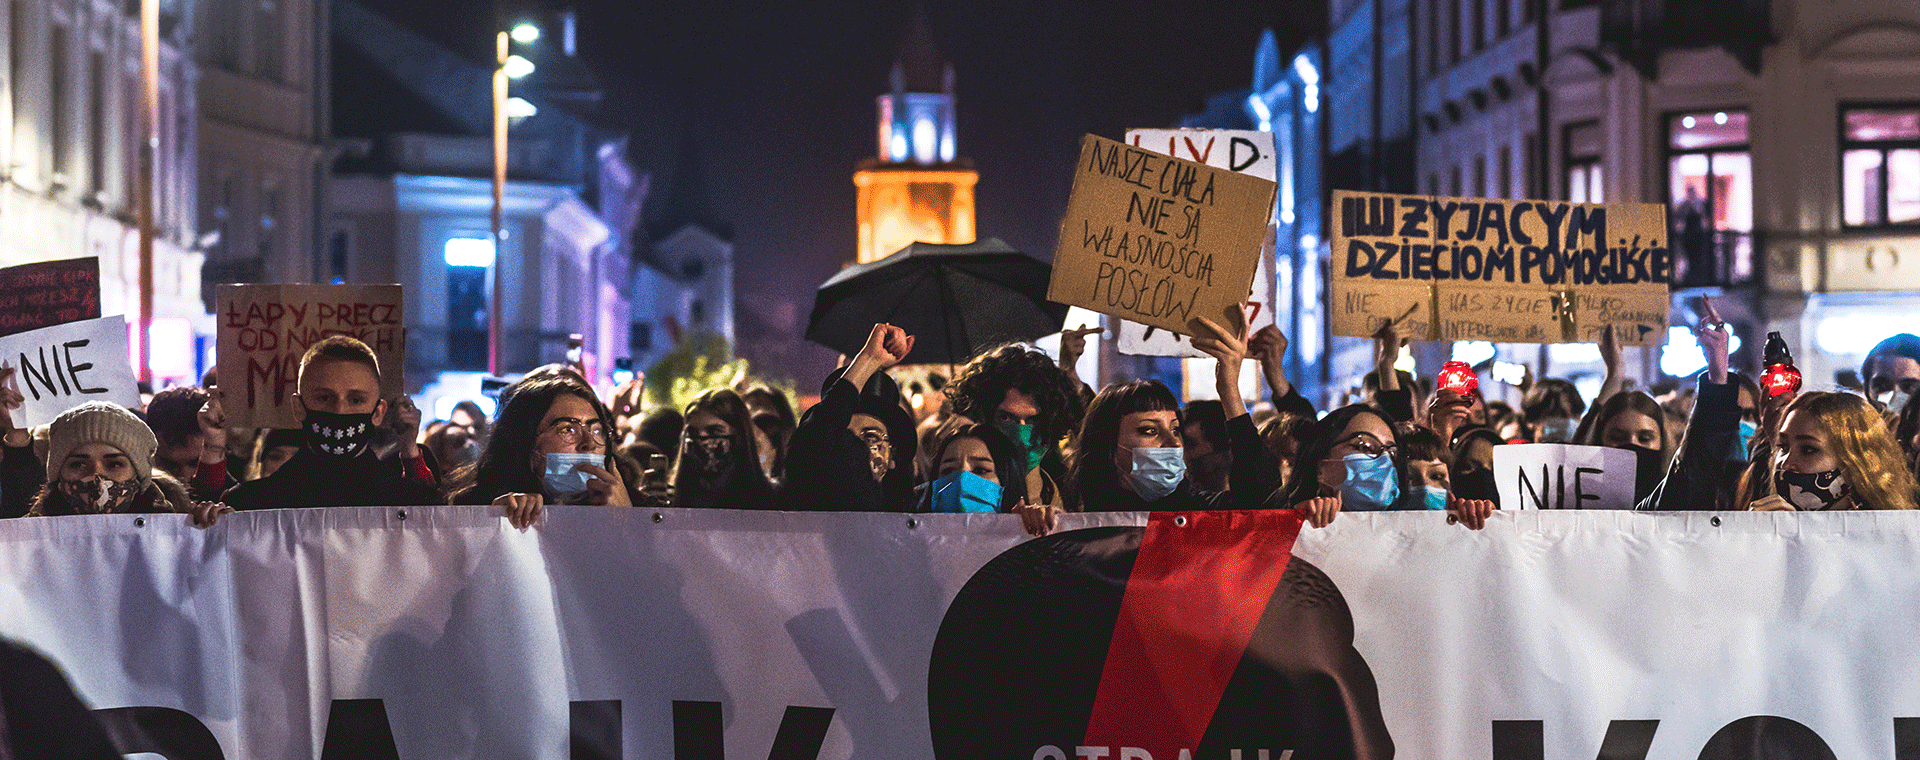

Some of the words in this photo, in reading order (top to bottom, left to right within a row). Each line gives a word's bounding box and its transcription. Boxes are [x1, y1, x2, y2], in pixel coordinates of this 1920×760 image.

[1088, 140, 1158, 190] NASZE
[1159, 159, 1215, 207] CIAŁA
[1126, 191, 1176, 236] NIE
[1175, 204, 1201, 248] SĄ
[1398, 197, 1607, 256] ŻYJĄCYM
[1345, 237, 1515, 284] DZIECIOM
[226, 301, 308, 329] ŁAPY
[318, 302, 398, 327] PRECZ
[1092, 261, 1201, 323] POSŁÓW
[1345, 289, 1379, 315] NIE
[1450, 292, 1483, 313] WAS
[238, 327, 279, 351] OD
[287, 326, 394, 352] NAYH
[20, 338, 109, 401] NIE
[1518, 463, 1604, 510] NIE
